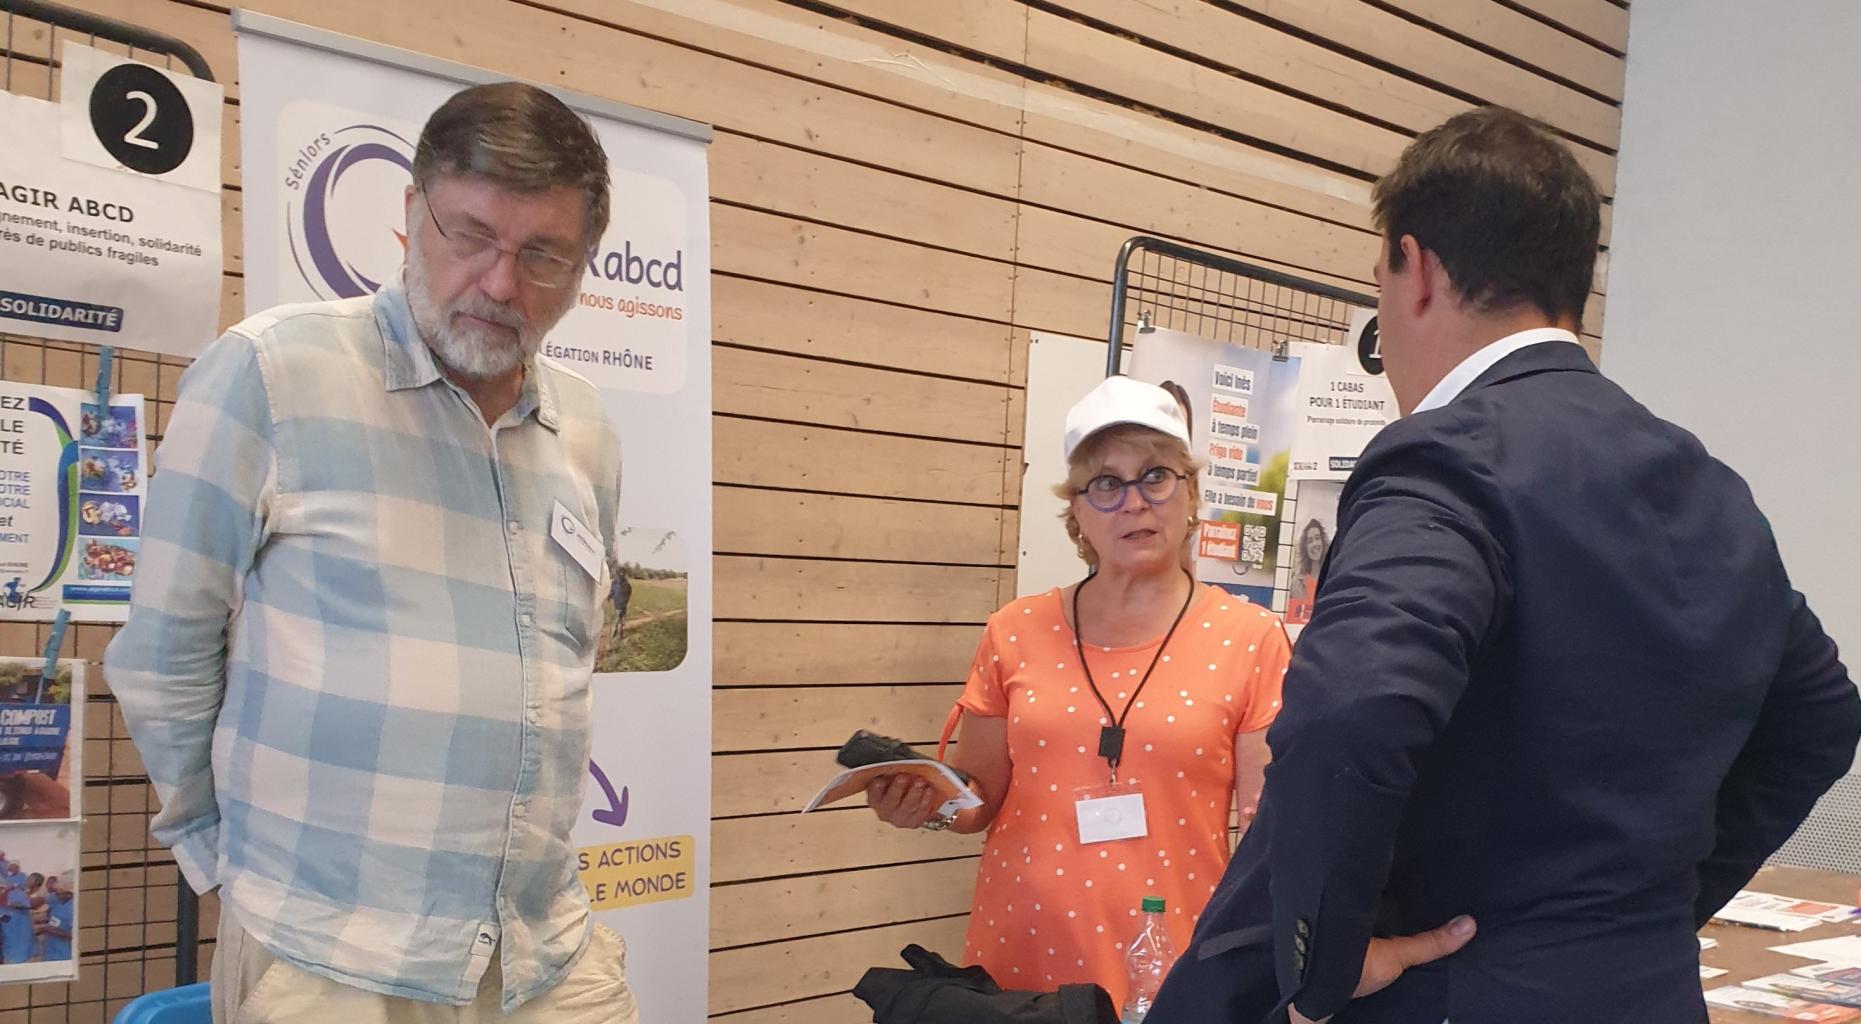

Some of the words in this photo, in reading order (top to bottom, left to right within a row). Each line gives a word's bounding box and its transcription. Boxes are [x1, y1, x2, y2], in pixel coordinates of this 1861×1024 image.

[124, 90, 159, 150] 2
[285, 133, 331, 190] Séniors
[68, 196, 134, 223] ABCD
[26, 232, 44, 246] de
[49, 239, 103, 257] publics
[107, 246, 159, 266] fragiles
[66, 221, 135, 246] insertion,
[138, 236, 202, 257] solidarité
[0, 297, 119, 326] SOLIDARITÉ
[580, 292, 614, 310] nous
[618, 296, 683, 320] agissons
[603, 348, 653, 370] RHÔNE
[1337, 381, 1364, 393] CABAS
[1309, 396, 1333, 408] POUR
[1342, 395, 1385, 411] ÉTUDIANT
[598, 841, 681, 869] ACTIONS
[590, 883, 607, 903] E
[614, 872, 687, 899] MONDE
